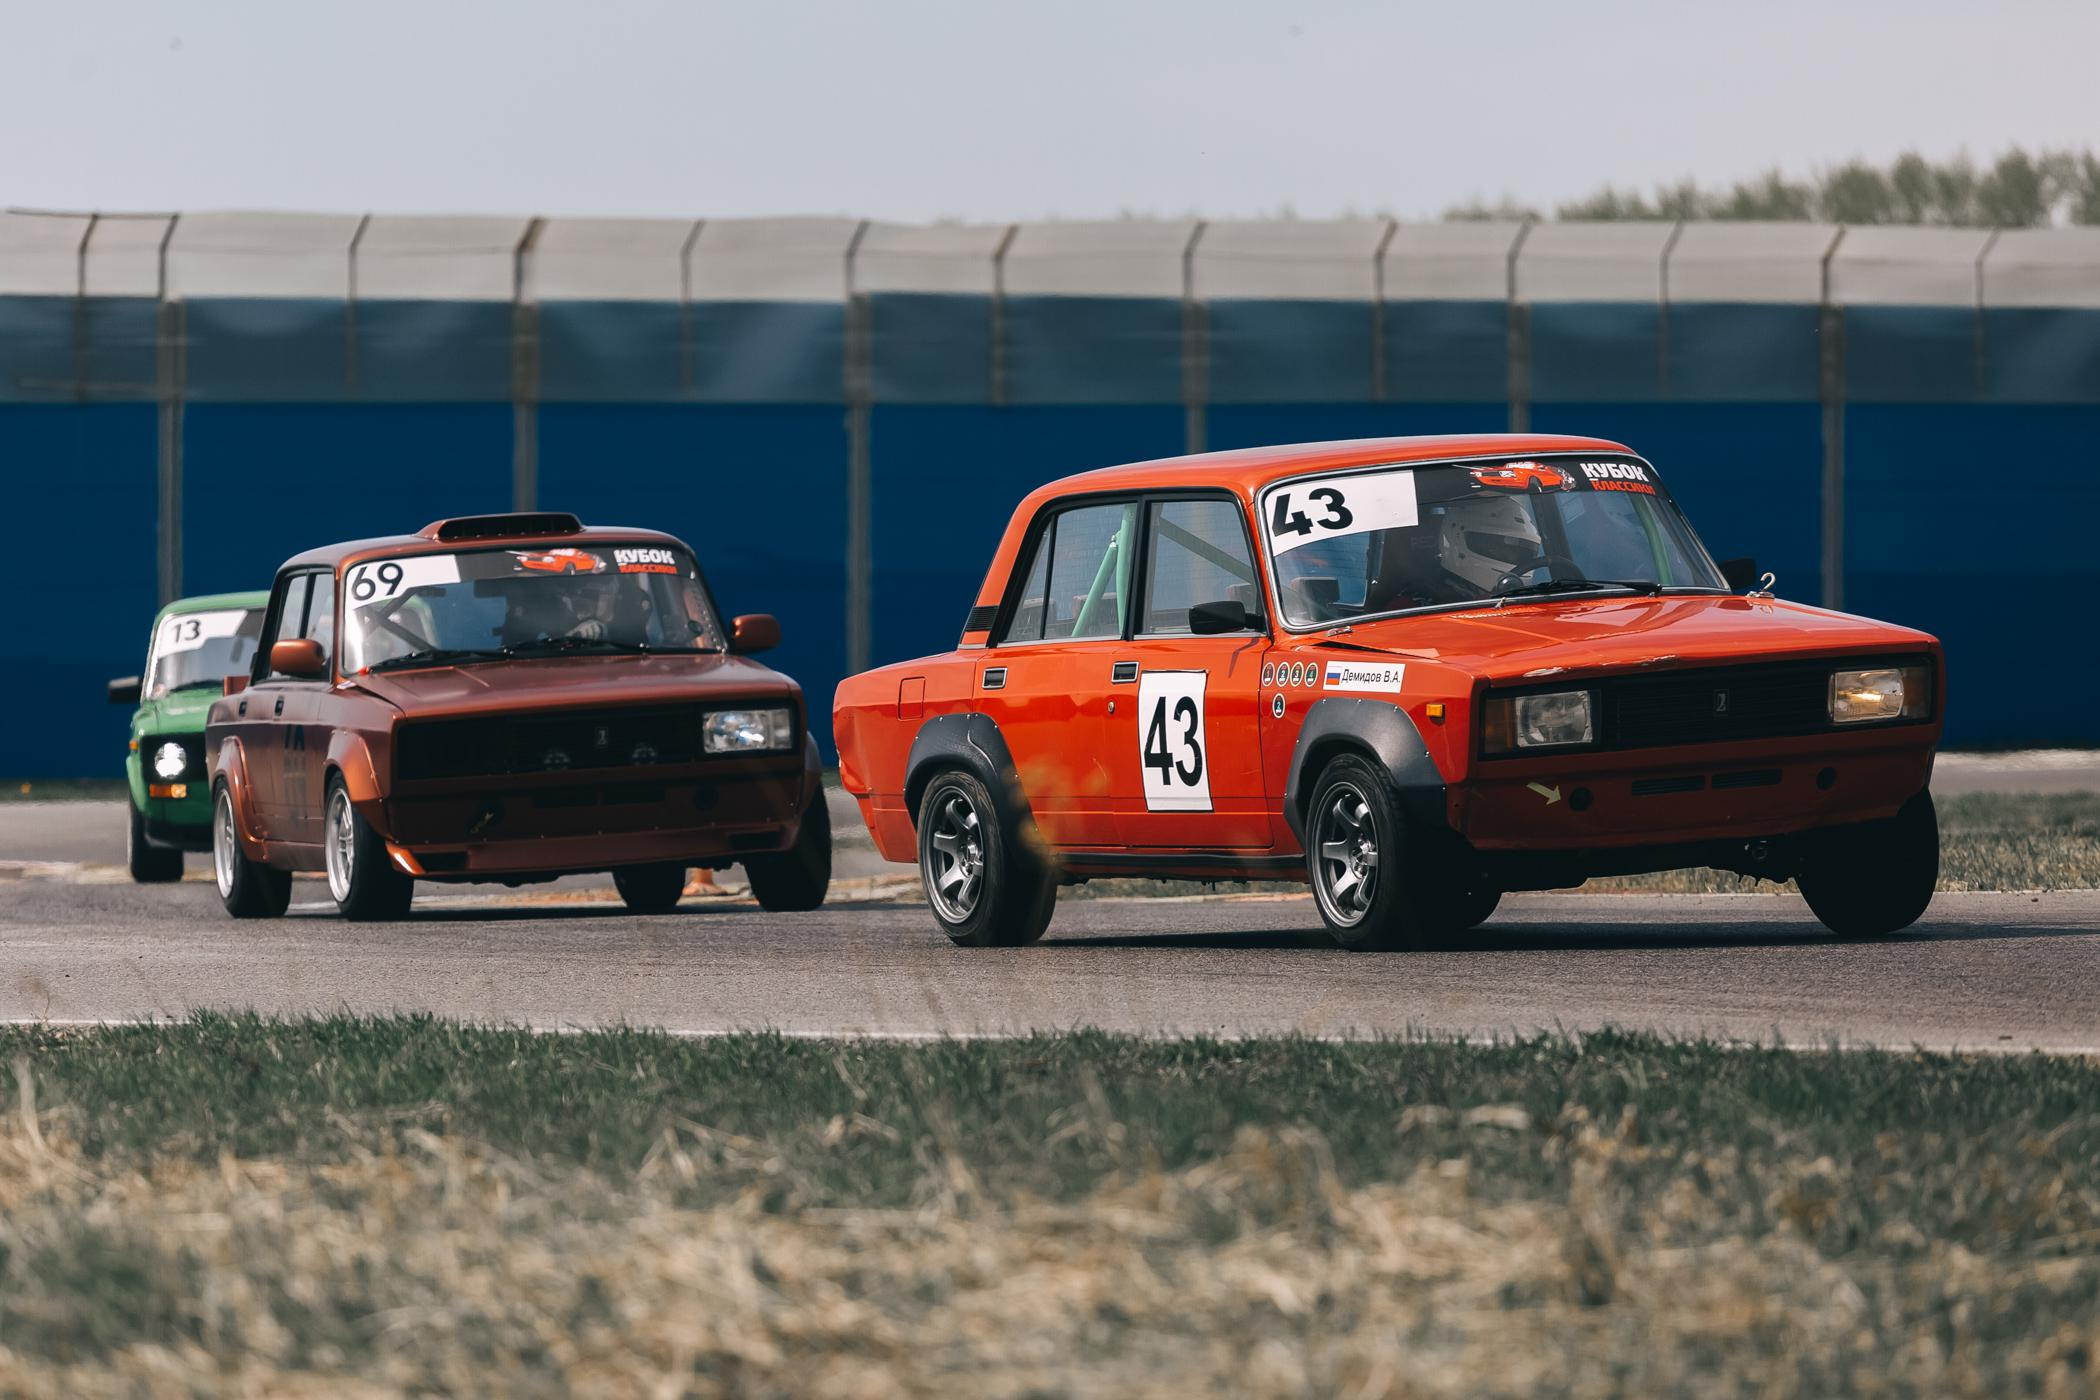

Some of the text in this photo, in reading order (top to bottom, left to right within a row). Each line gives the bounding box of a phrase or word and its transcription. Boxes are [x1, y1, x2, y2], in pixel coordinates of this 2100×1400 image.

[1580, 463, 1649, 482] КУБОК
[1272, 487, 1353, 537] 43
[613, 548, 676, 565] КУБОК
[351, 562, 404, 601] 69
[173, 619, 202, 643] 13
[1341, 668, 1382, 684] Демидов
[1144, 696, 1203, 787] 43
